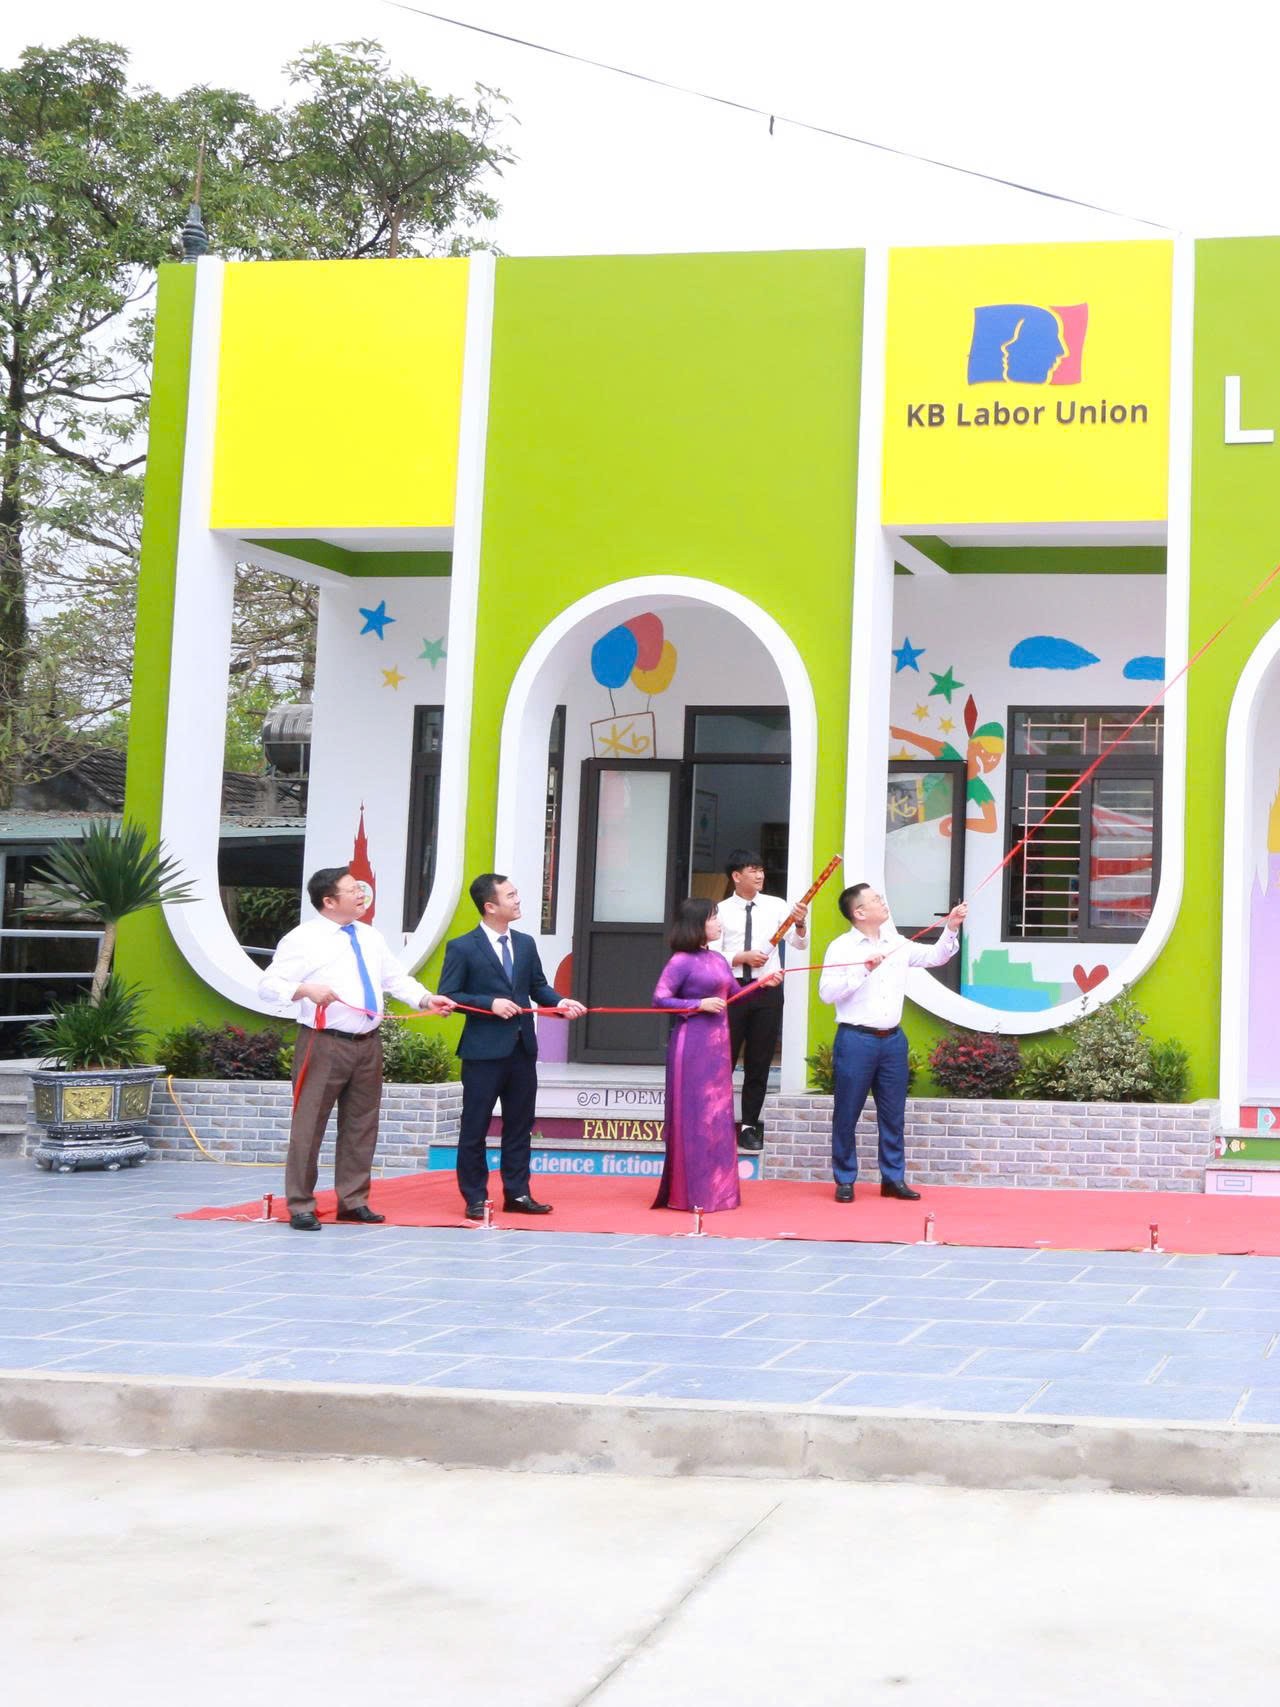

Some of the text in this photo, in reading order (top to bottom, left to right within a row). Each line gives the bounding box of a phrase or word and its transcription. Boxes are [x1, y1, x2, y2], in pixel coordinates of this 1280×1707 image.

[907, 400, 1148, 427] KB Labor Union
[614, 1089, 666, 1105] POEM
[583, 1119, 664, 1141] FANTASY
[602, 1154, 664, 1175] fiction
